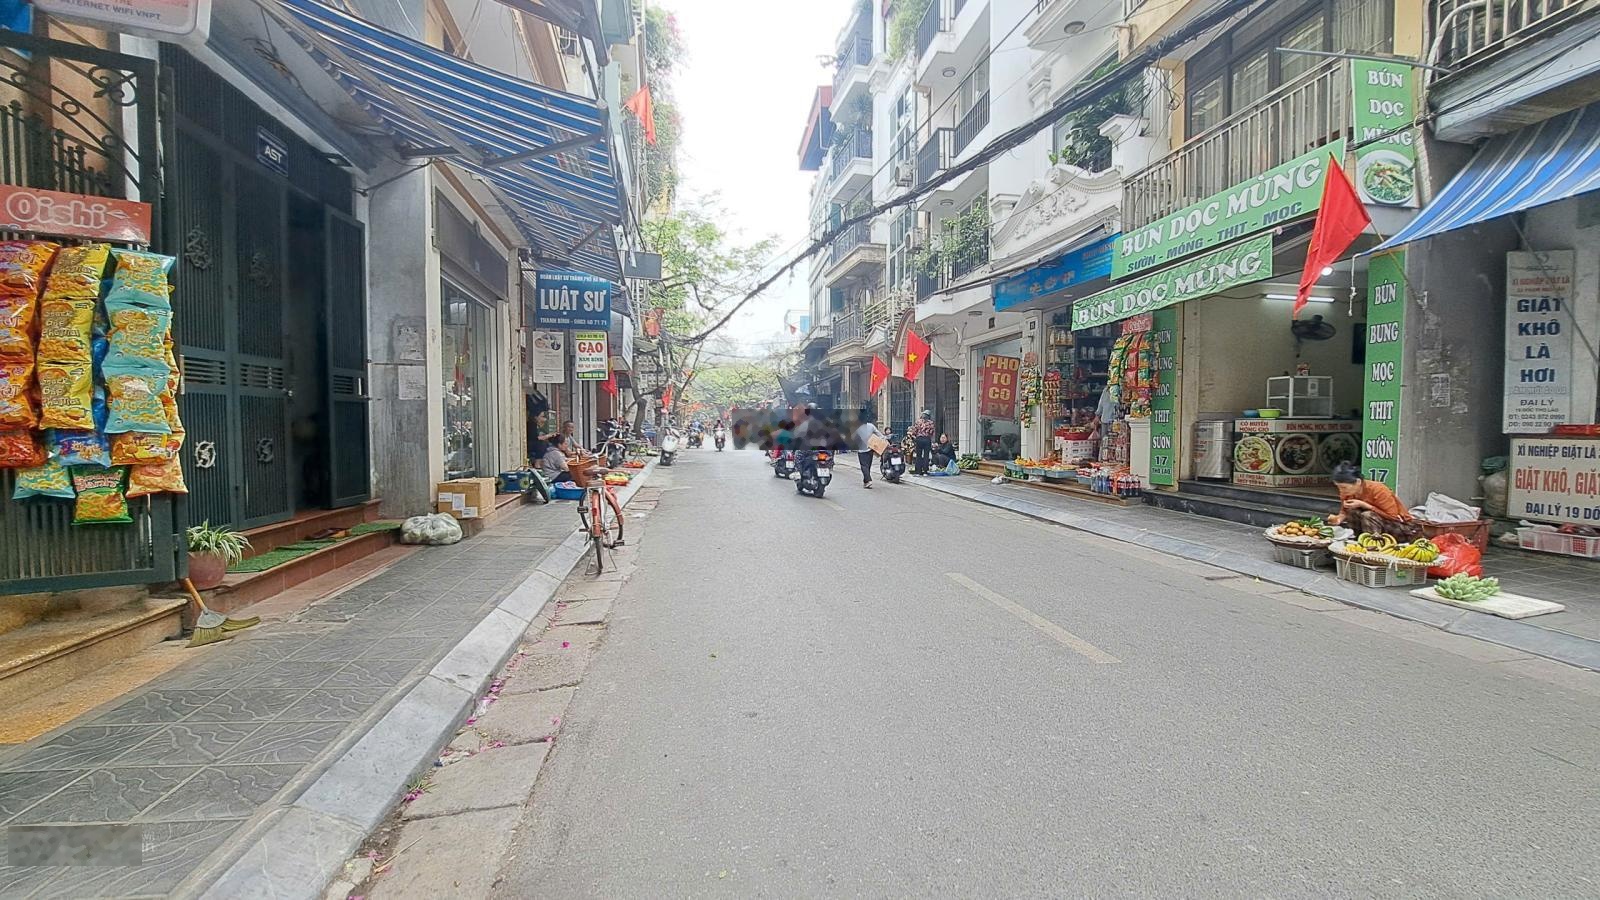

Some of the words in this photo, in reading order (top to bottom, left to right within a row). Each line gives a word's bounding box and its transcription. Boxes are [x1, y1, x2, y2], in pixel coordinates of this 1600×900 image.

[113, 5, 134, 16] WIFI
[136, 10, 161, 20] VNPT
[1367, 68, 1403, 88] BÚN
[1369, 99, 1405, 119] DỌC
[265, 145, 282, 164] AST
[6, 192, 108, 229] Oishi
[1121, 223, 1165, 258] BÚN
[1168, 201, 1220, 238] DỌC
[1225, 157, 1322, 219] MÙNG
[1167, 238, 1204, 259] MÓNG
[1076, 299, 1117, 325] BÚN
[1122, 283, 1169, 313] DỌC
[1174, 251, 1262, 297] MÙNG
[1374, 279, 1398, 305] BÚN
[540, 285, 579, 315] LUẬT
[583, 290, 607, 312] SƯ
[1517, 296, 1563, 315] GIẶT
[1369, 321, 1399, 344] BUNG
[1518, 319, 1560, 336] KHÔ
[578, 342, 604, 356] GẠO
[1526, 343, 1551, 359] LÀ
[986, 355, 1020, 371] PHO
[1158, 356, 1173, 370] UNG
[991, 371, 1012, 386] TO
[1371, 361, 1394, 386] MỌC
[1520, 367, 1556, 383] HƠI
[987, 402, 1009, 416] PY
[1369, 401, 1394, 425] THỊT
[1365, 434, 1394, 459] SƯỜN
[1528, 443, 1559, 460] NGHIỆP
[1561, 444, 1583, 460] GIẶT
[1585, 444, 1596, 459] LÀ
[1155, 456, 1168, 466] 17
[1369, 468, 1389, 483] 17
[1515, 465, 1541, 494] GIẶT
[1543, 467, 1571, 496] KHÔ,
[1526, 502, 1545, 516] ĐẠI
[1547, 502, 1562, 516] LÝ
[1565, 506, 1580, 518] 19
